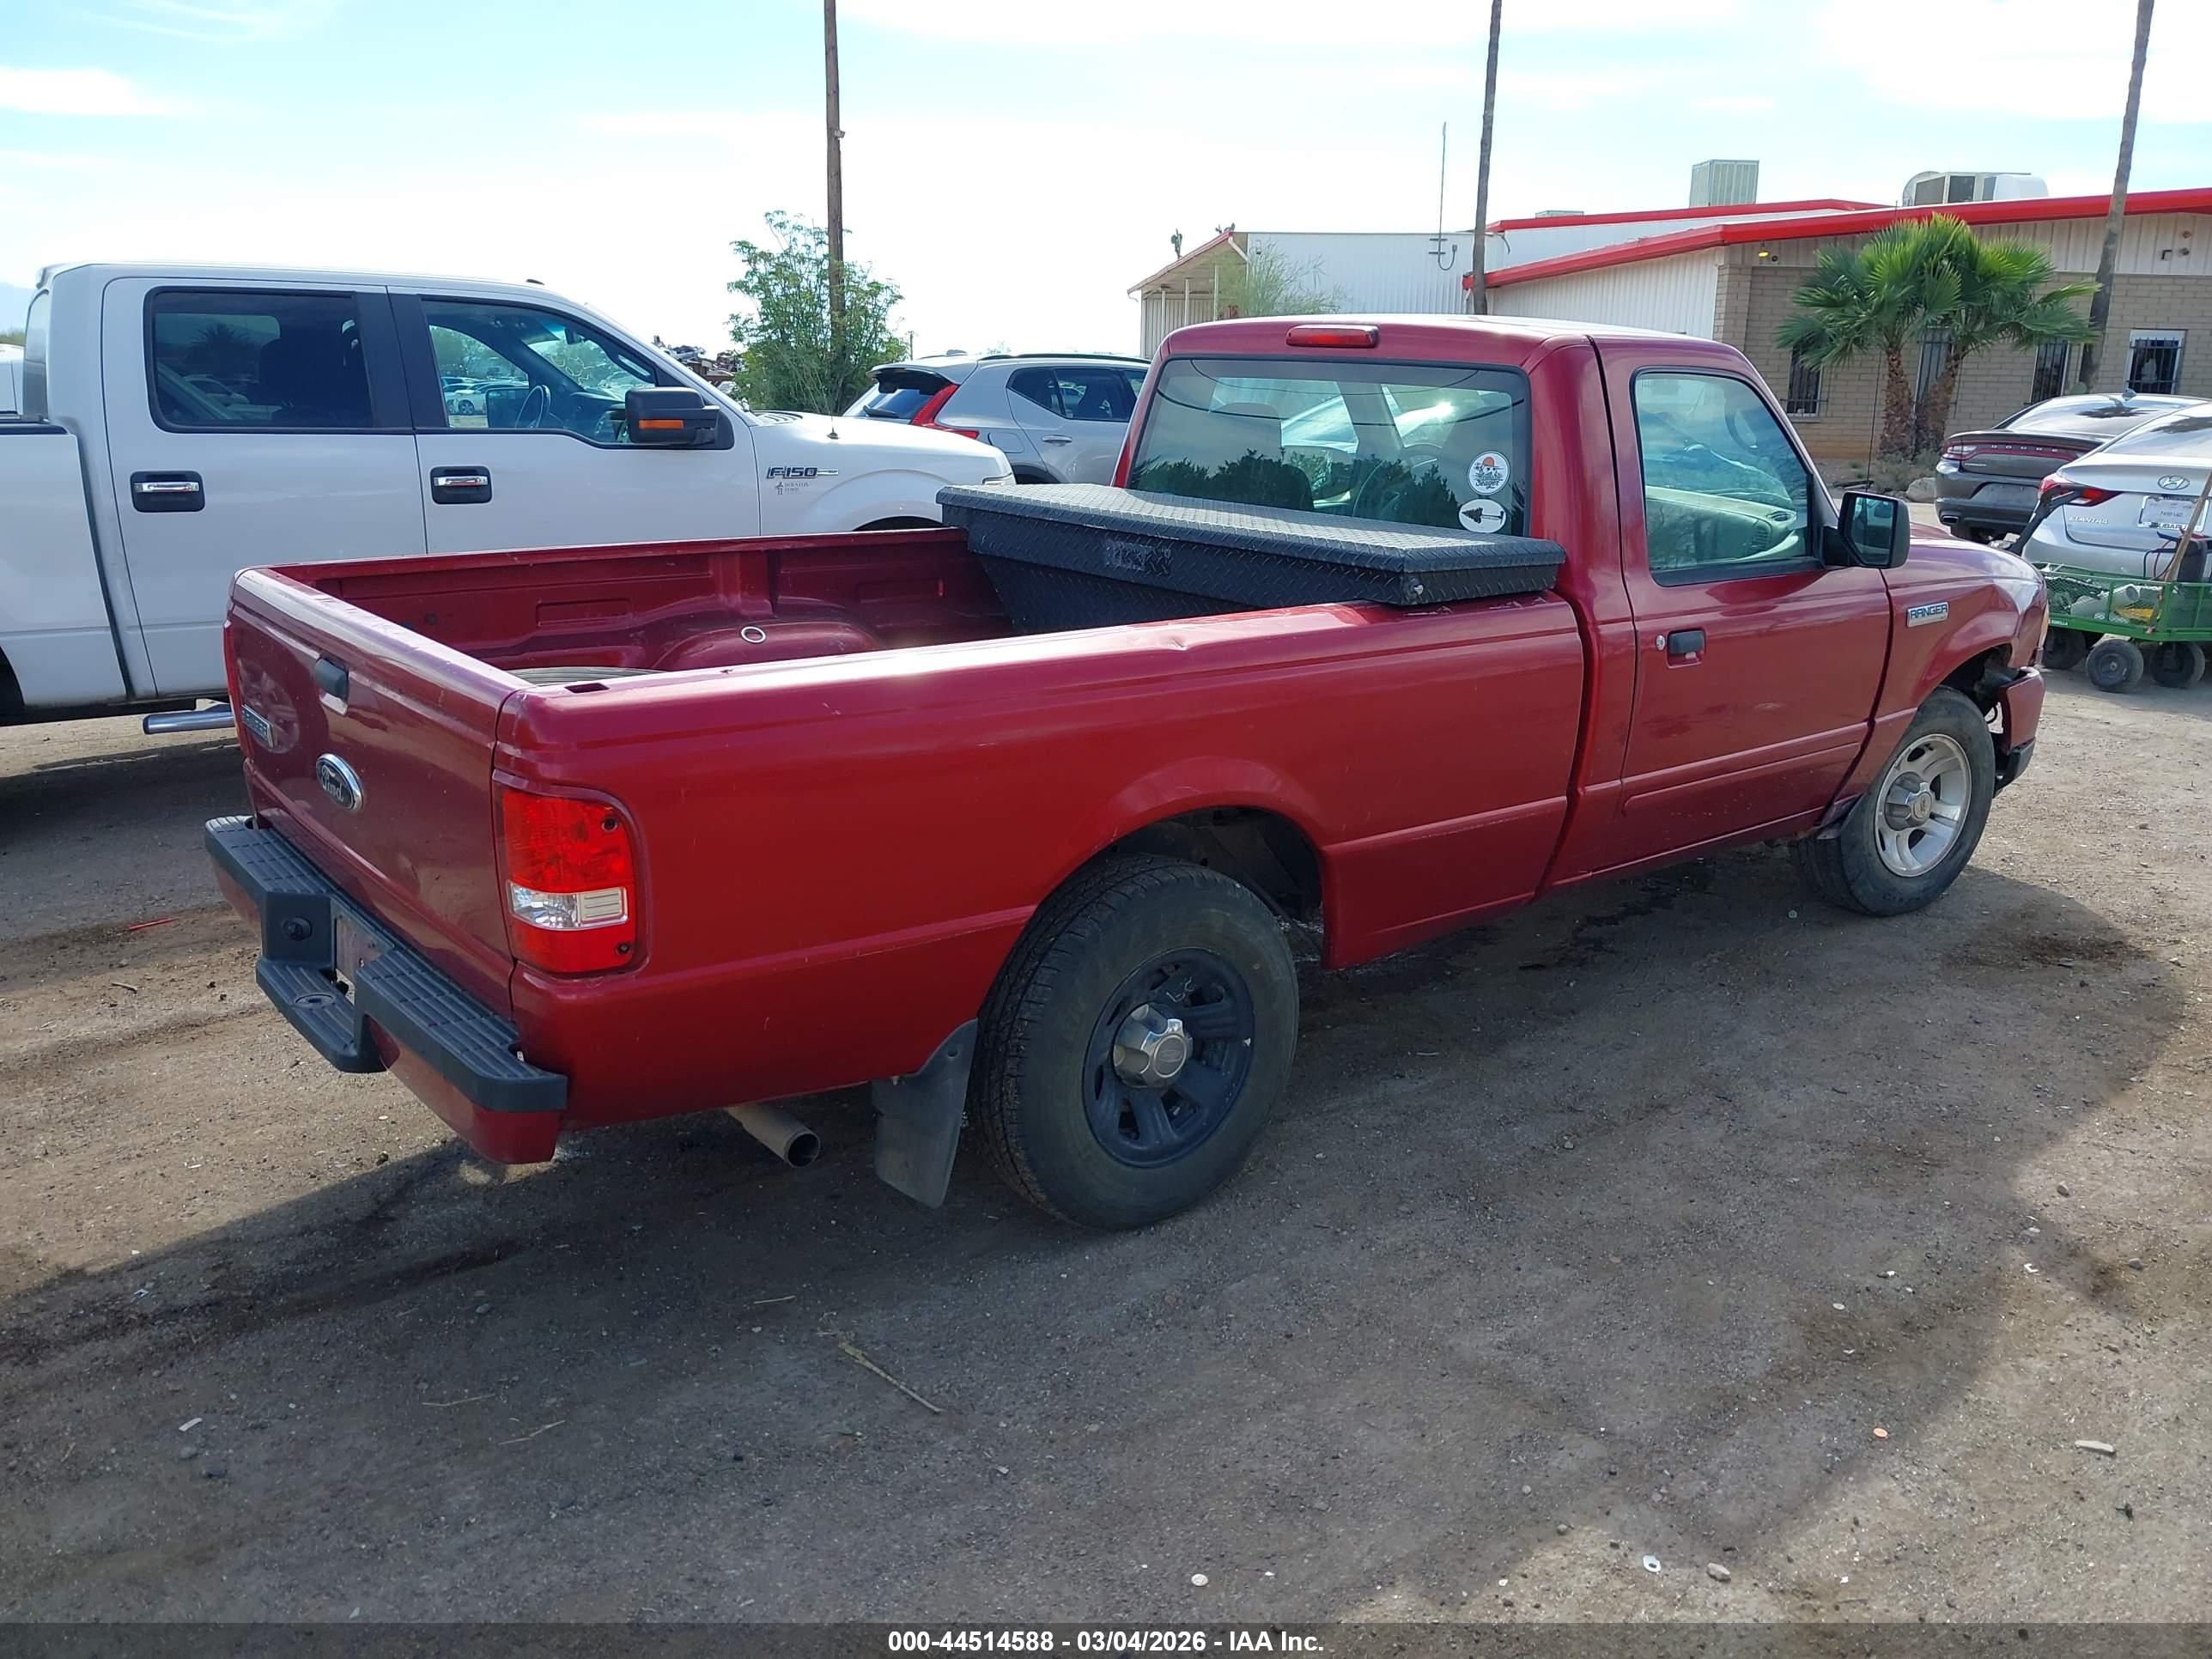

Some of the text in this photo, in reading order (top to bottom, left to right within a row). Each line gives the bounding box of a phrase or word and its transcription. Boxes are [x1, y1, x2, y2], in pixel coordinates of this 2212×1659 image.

[767, 466, 817, 479] F-150
[1910, 603, 1948, 619] RANGER
[321, 763, 345, 803] Ford
